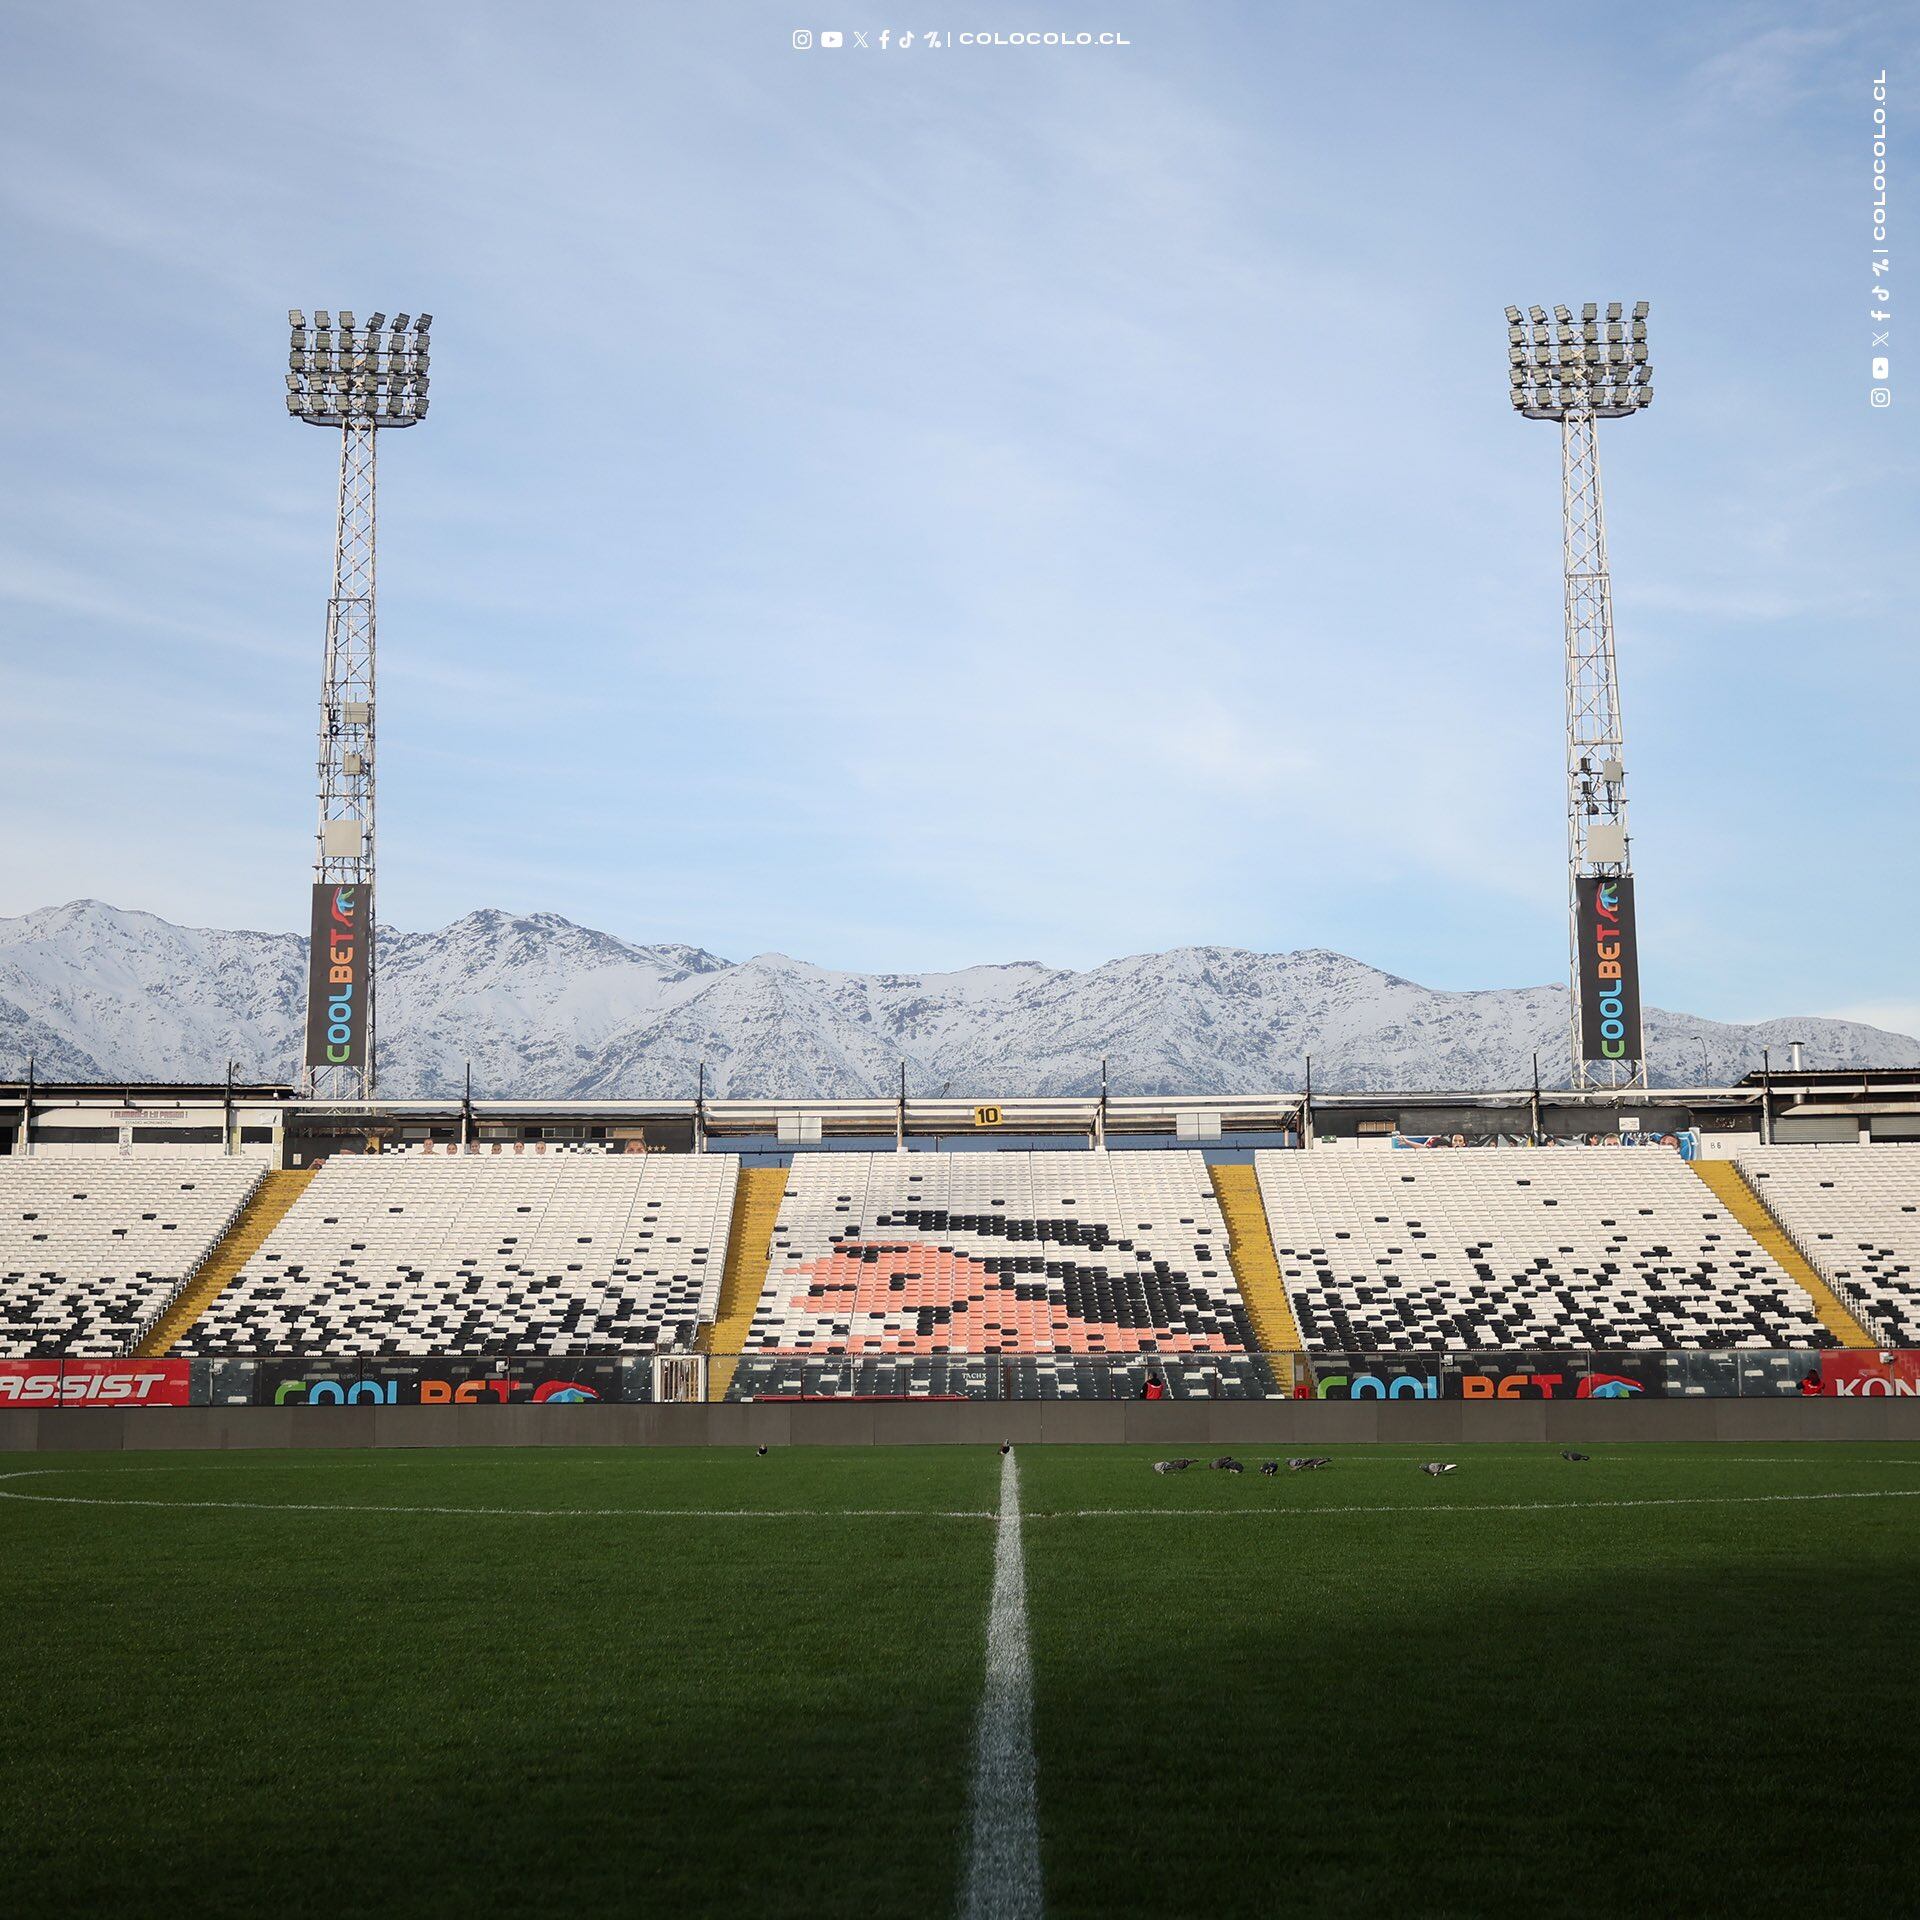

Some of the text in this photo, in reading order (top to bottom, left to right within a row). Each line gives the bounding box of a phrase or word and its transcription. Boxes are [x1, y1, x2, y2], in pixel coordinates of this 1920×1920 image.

[327, 928, 354, 1063] COOLBET
[1597, 924, 1625, 1058] COOLBET
[978, 1107, 998, 1123] 10
[0, 1374, 166, 1400] ASSIST
